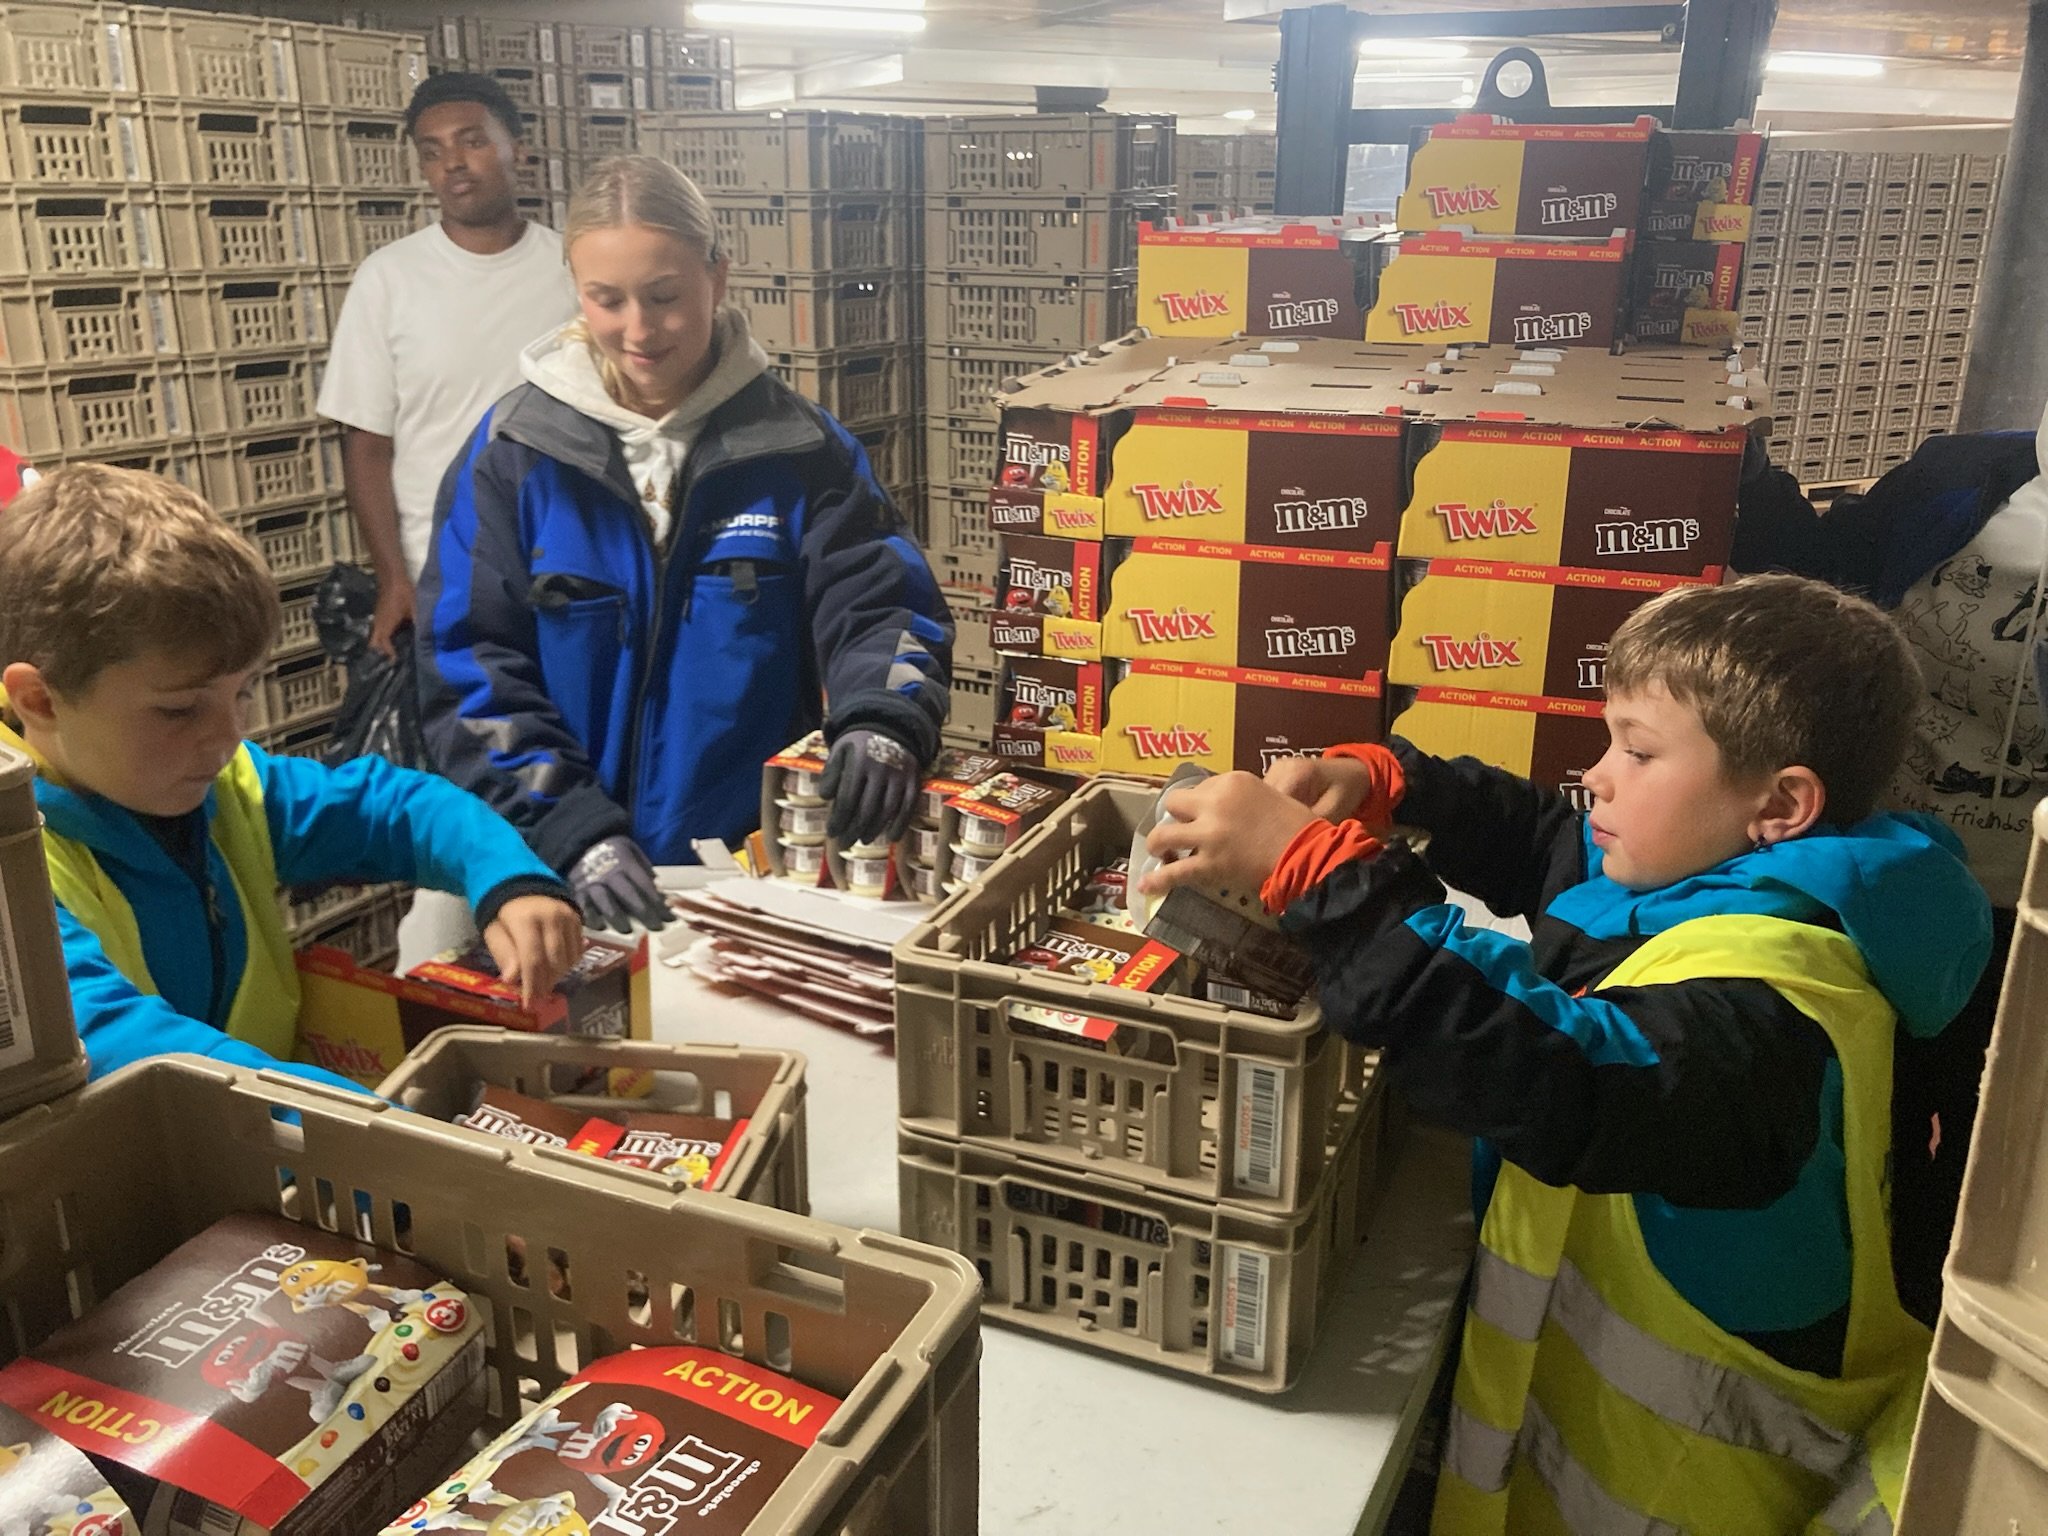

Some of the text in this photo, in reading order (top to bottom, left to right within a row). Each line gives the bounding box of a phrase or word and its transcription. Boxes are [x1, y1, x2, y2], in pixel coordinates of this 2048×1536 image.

[1451, 127, 1647, 139] ACTION ACTION ACTION ACTION ACTION
[1734, 157, 1752, 205] ACTION
[1426, 183, 1500, 216] Twix
[1294, 238, 1322, 246] ACTION
[1420, 244, 1621, 259] ACTION ACTION ACTION ACTION ACTION
[1715, 266, 1733, 310] ACTION
[1160, 289, 1230, 322] Twix
[1396, 300, 1471, 333] Twix
[1156, 413, 1398, 433] ACTION ACTION ACTION ACTION ACTION
[1468, 428, 1740, 451] ACTION ACTION ACTION ACTION ACTION
[1076, 440, 1090, 495] ACTION
[1132, 480, 1224, 521] Twix
[1052, 508, 1096, 528] Twix
[1436, 498, 1539, 541] Twix
[1152, 541, 1385, 566] ACTION ACTION ACTION ACTION ACTION
[1454, 564, 1493, 574] ACTION
[1507, 568, 1546, 579] ACTION
[1566, 573, 1605, 584] ACTION
[1621, 577, 1661, 588] ACTION
[1079, 566, 1092, 620] ACTION
[1051, 631, 1094, 649] Twix
[1127, 605, 1216, 644] Twix
[1421, 631, 1521, 671] Twix
[1150, 663, 1376, 694] ACTION ACTION ACTION ACTION ACTION
[1083, 685, 1096, 735] ACTION
[1439, 690, 1586, 713] ACTION ACTION ACTION
[1053, 745, 1094, 763] Twix
[1126, 723, 1212, 760] Twix
[954, 800, 1012, 820] ACTION
[421, 964, 481, 986] ACTION
[1119, 953, 1163, 989] ACTION
[664, 1359, 814, 1425] ACTION
[698, 1460, 761, 1516] chocolate
